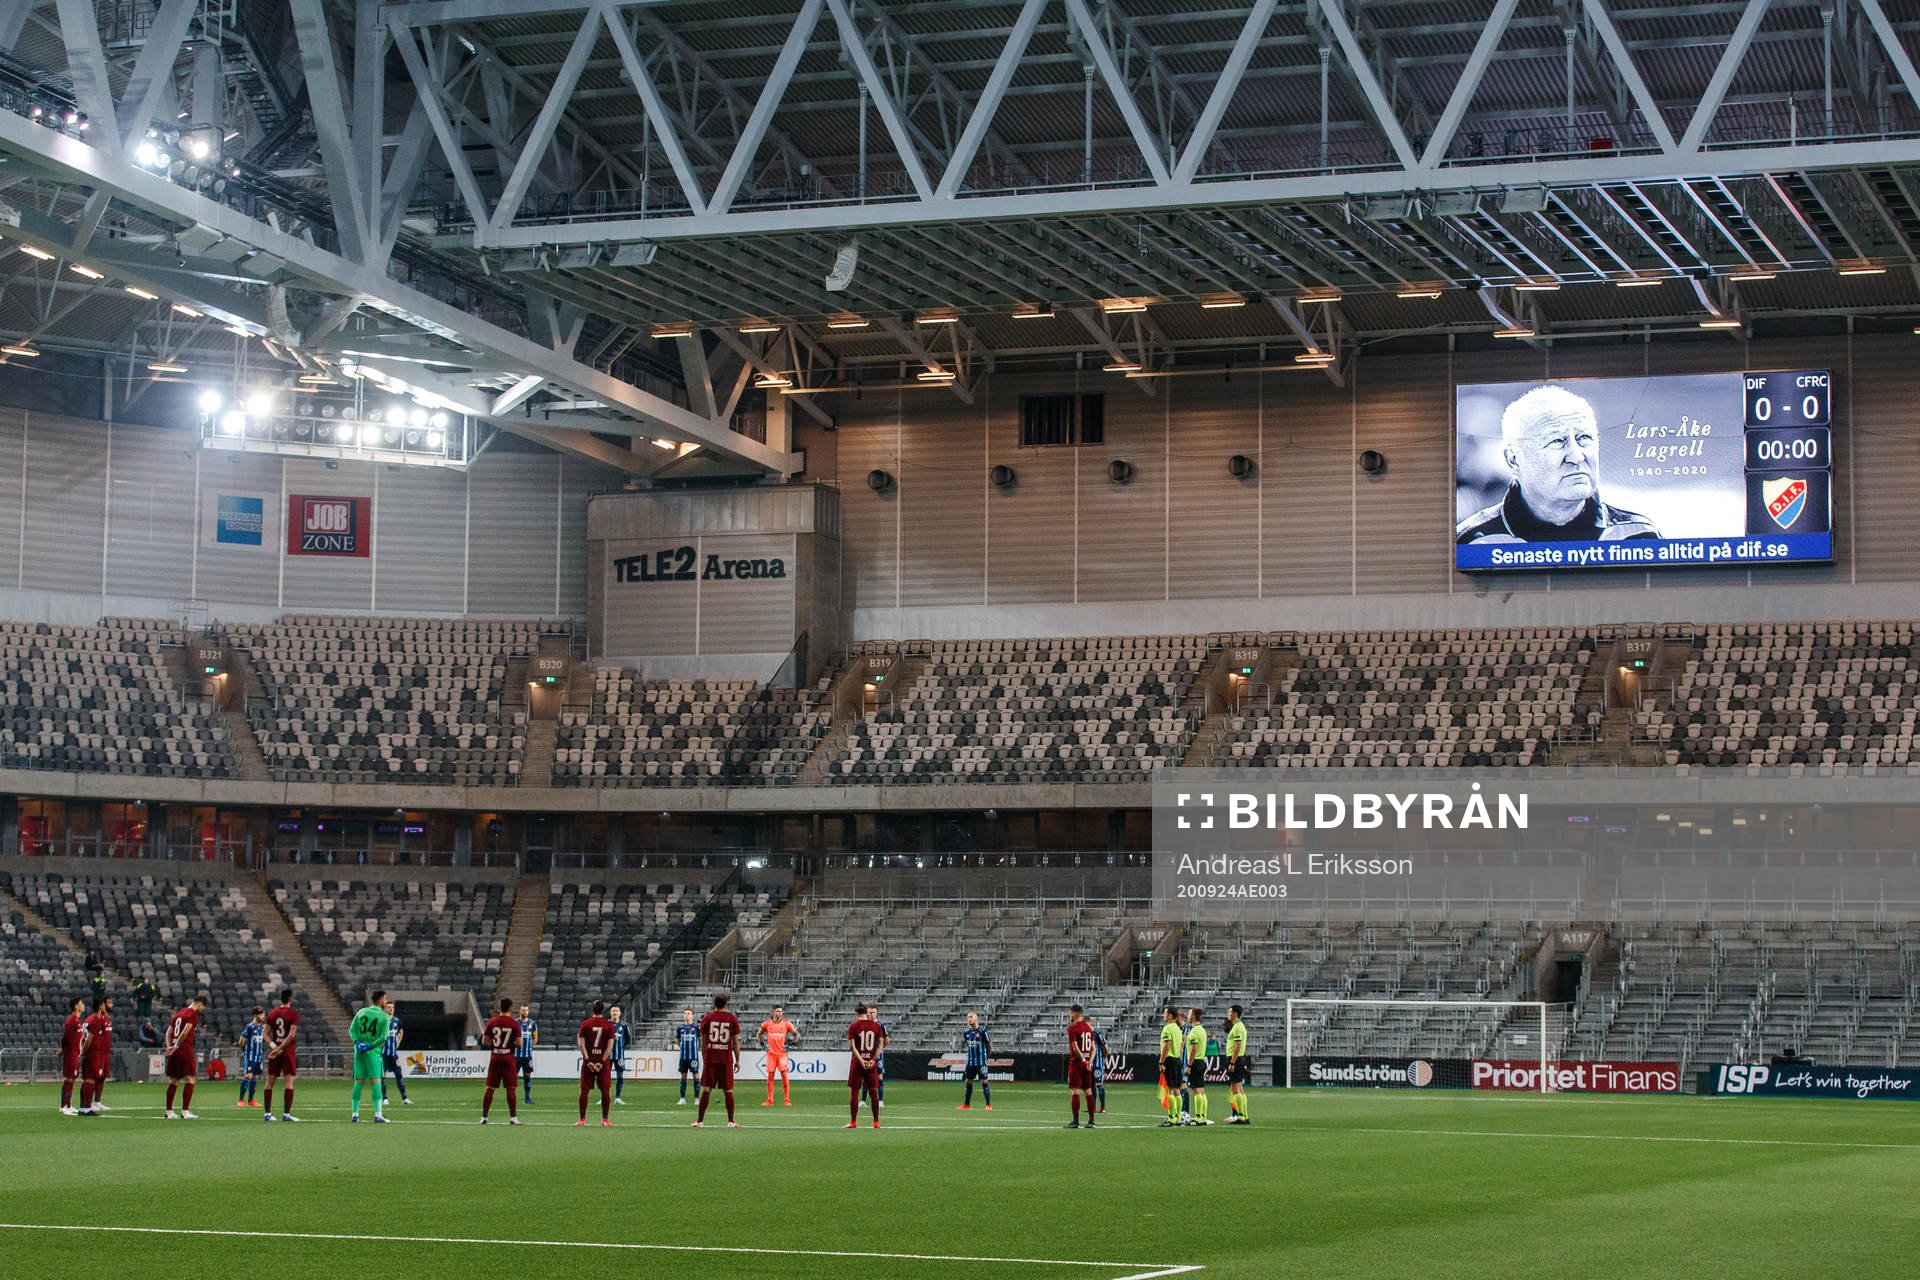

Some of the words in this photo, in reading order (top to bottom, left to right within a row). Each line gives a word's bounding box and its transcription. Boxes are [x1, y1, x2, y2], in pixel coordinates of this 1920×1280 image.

[1746, 378, 1767, 390] DIF
[1796, 375, 1828, 388] CFRC
[1755, 397, 1771, 421] 0
[1802, 395, 1819, 419] 0
[1625, 415, 1712, 438] Lars-Åke
[1633, 439, 1704, 462] Lagrell
[1758, 438, 1817, 460] 00:00
[306, 503, 348, 531] JOB
[303, 534, 355, 551] ZONE
[1491, 548, 1563, 564] Senaste
[1567, 546, 1604, 565] nytt
[1608, 544, 1655, 561] finns
[1658, 542, 1704, 560] alltid
[1709, 541, 1732, 562] på
[1736, 540, 1789, 558] dif.se
[614, 546, 696, 582] TELE2
[702, 554, 786, 580] Arena
[199, 649, 222, 659] B321
[1235, 650, 1259, 660] B318
[1626, 642, 1652, 653] B317
[539, 660, 563, 669] B320
[869, 658, 892, 668] B319
[1562, 932, 1591, 943] A117
[173, 1017, 182, 1037] 8
[275, 1018, 286, 1038] 3
[360, 1015, 379, 1036] 34
[709, 1021, 730, 1043] 55
[492, 1026, 512, 1048] 37
[592, 1026, 603, 1047] 7
[858, 1030, 875, 1051] 10
[1080, 1031, 1092, 1051] 16
[425, 1055, 467, 1065] Haninge
[426, 1064, 486, 1075] Terrazzogolv
[1104, 1067, 1135, 1081] eknik
[1309, 1063, 1407, 1083] Sundström
[1473, 1062, 1587, 1089] Priortet
[1592, 1064, 1677, 1091] Finans
[1717, 1065, 1769, 1093] ISP
[1775, 1072, 1812, 1088] Let's
[1816, 1073, 1842, 1089] win
[1845, 1073, 1912, 1098] together
